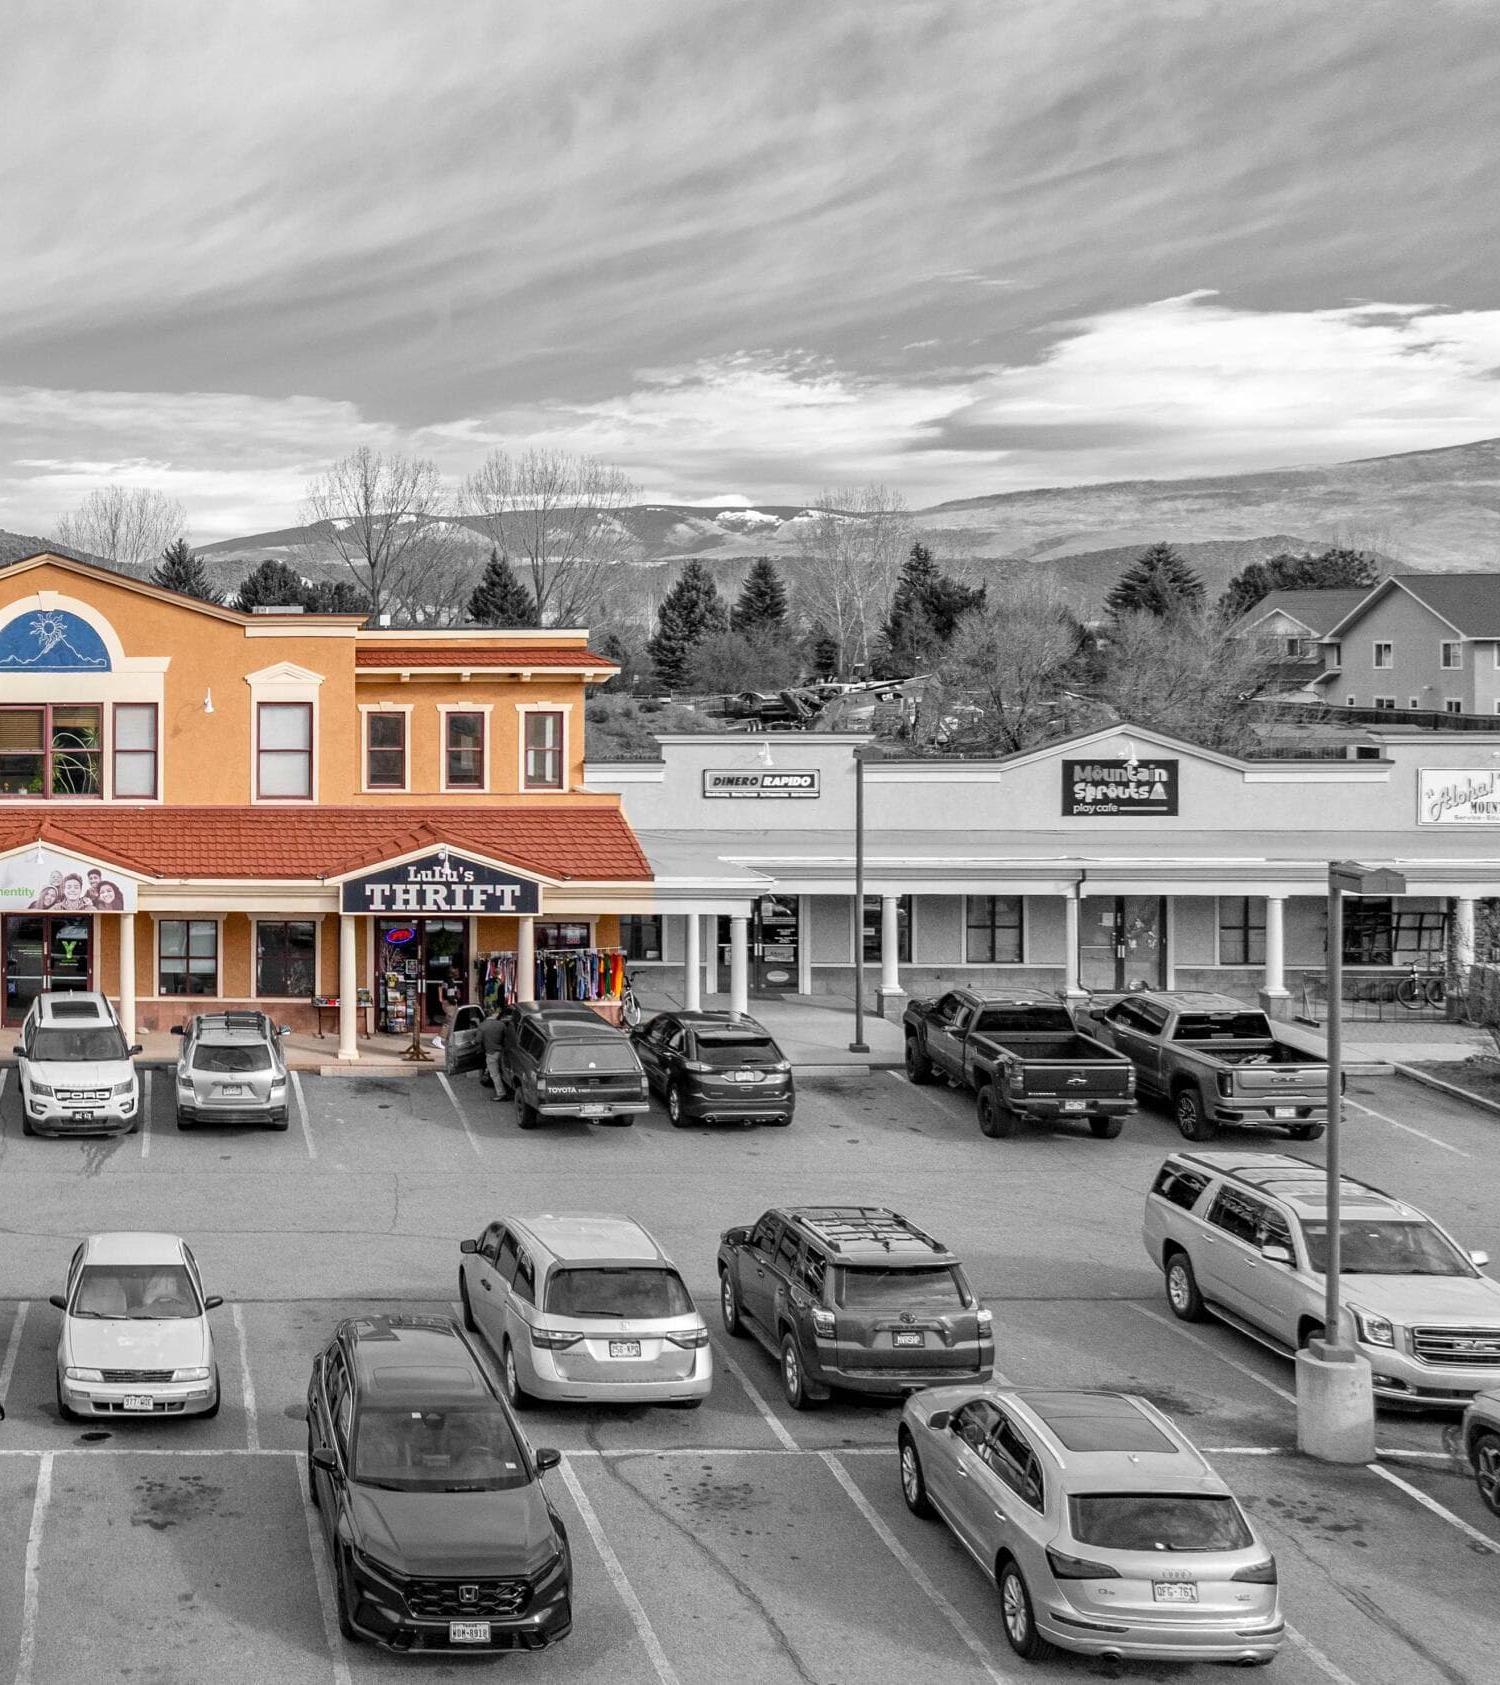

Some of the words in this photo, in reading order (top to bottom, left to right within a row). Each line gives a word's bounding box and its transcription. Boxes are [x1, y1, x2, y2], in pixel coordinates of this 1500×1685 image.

[1073, 764, 1169, 782] Mountain
[712, 776, 759, 787] DINERO
[762, 776, 812, 787] RAPIDO
[1073, 782, 1150, 802] Sprouts
[1073, 803, 1095, 814] play
[1096, 803, 1118, 813] cafe
[1470, 801, 1500, 814] MOUN
[365, 884, 521, 911] THRIFT
[56, 1091, 110, 1099] FORD
